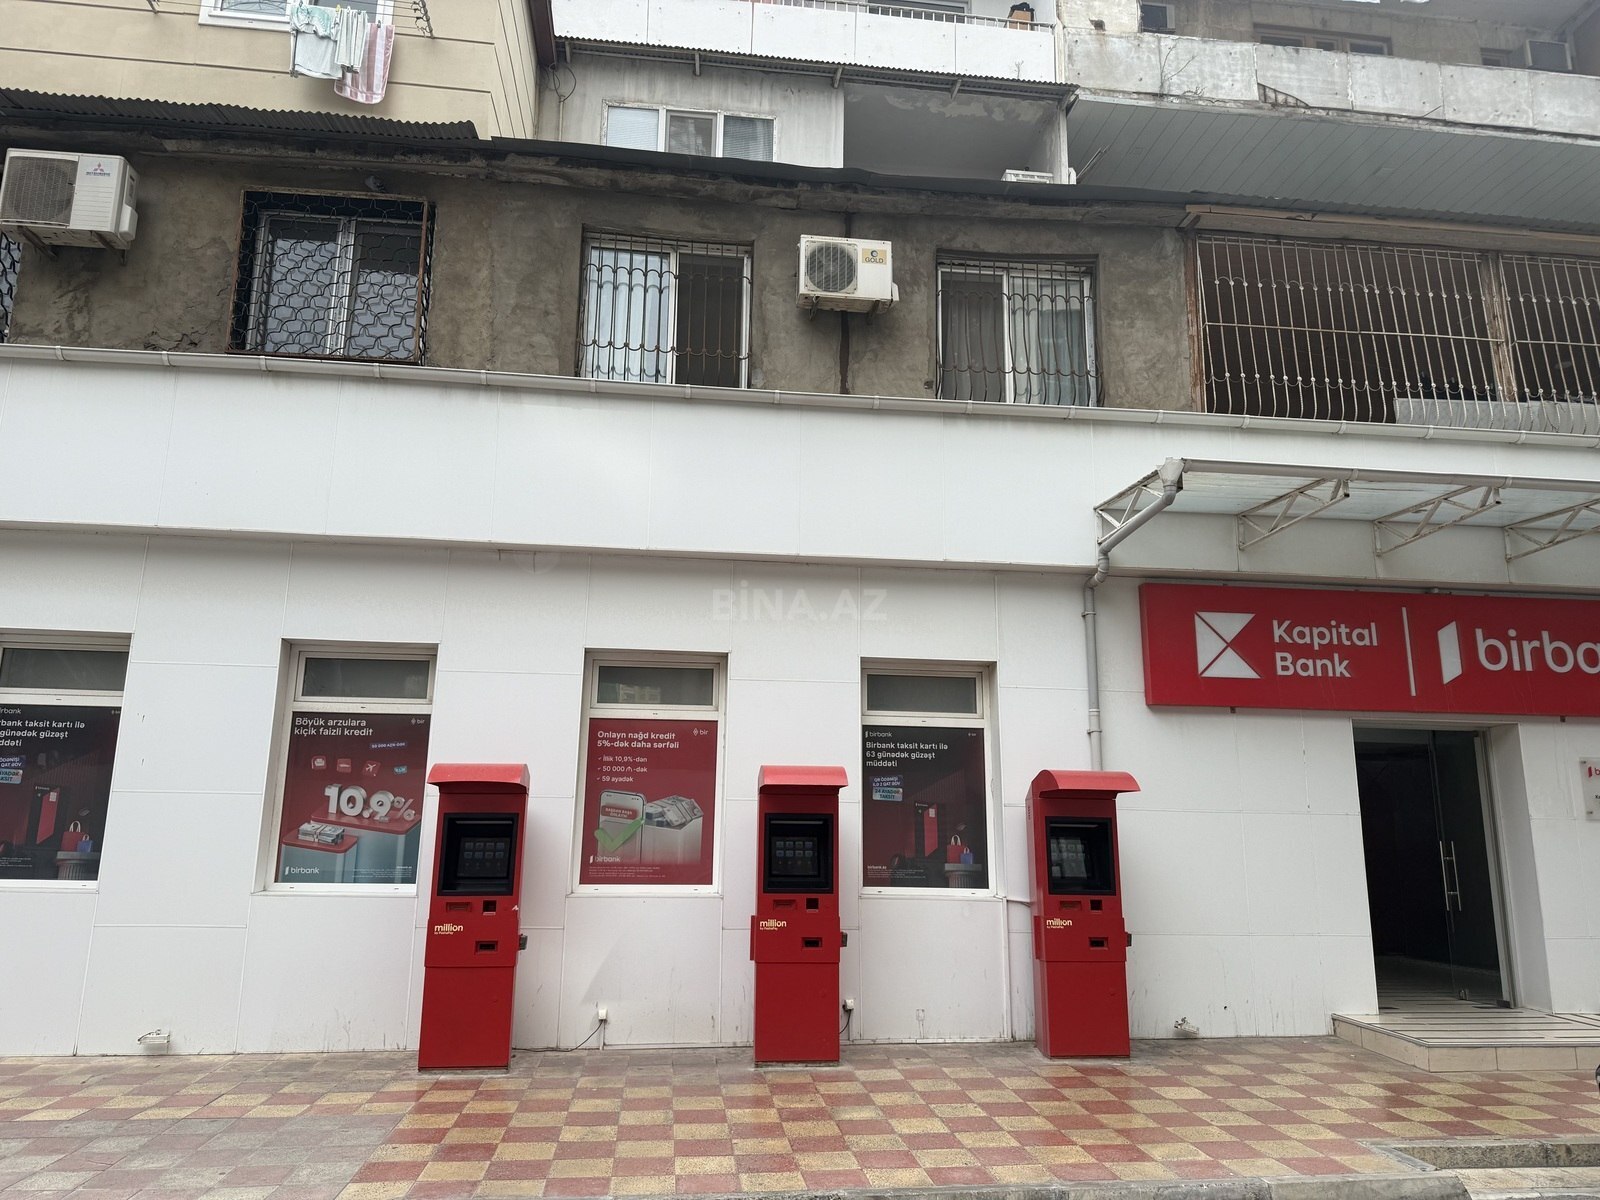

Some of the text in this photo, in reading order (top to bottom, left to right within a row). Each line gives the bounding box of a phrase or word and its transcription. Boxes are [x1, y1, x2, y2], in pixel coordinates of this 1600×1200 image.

[1272, 619, 1378, 650] Kapital
[1275, 652, 1351, 677] Bank
[0, 719, 86, 729] bank taksit kartı ilə
[295, 717, 367, 727] Böyük arzulara
[0, 729, 68, 740] günədək güzəşt
[294, 727, 373, 737] kiçik faizli kredit
[597, 731, 675, 741] Onlayn nağd kredit
[597, 740, 629, 748] 5%-dək
[919, 742, 938, 750] kartı
[877, 751, 909, 759] günədək
[911, 751, 936, 760] güzəşt
[290, 866, 320, 874] birbank
[434, 923, 463, 931] million
[760, 919, 787, 927] million
